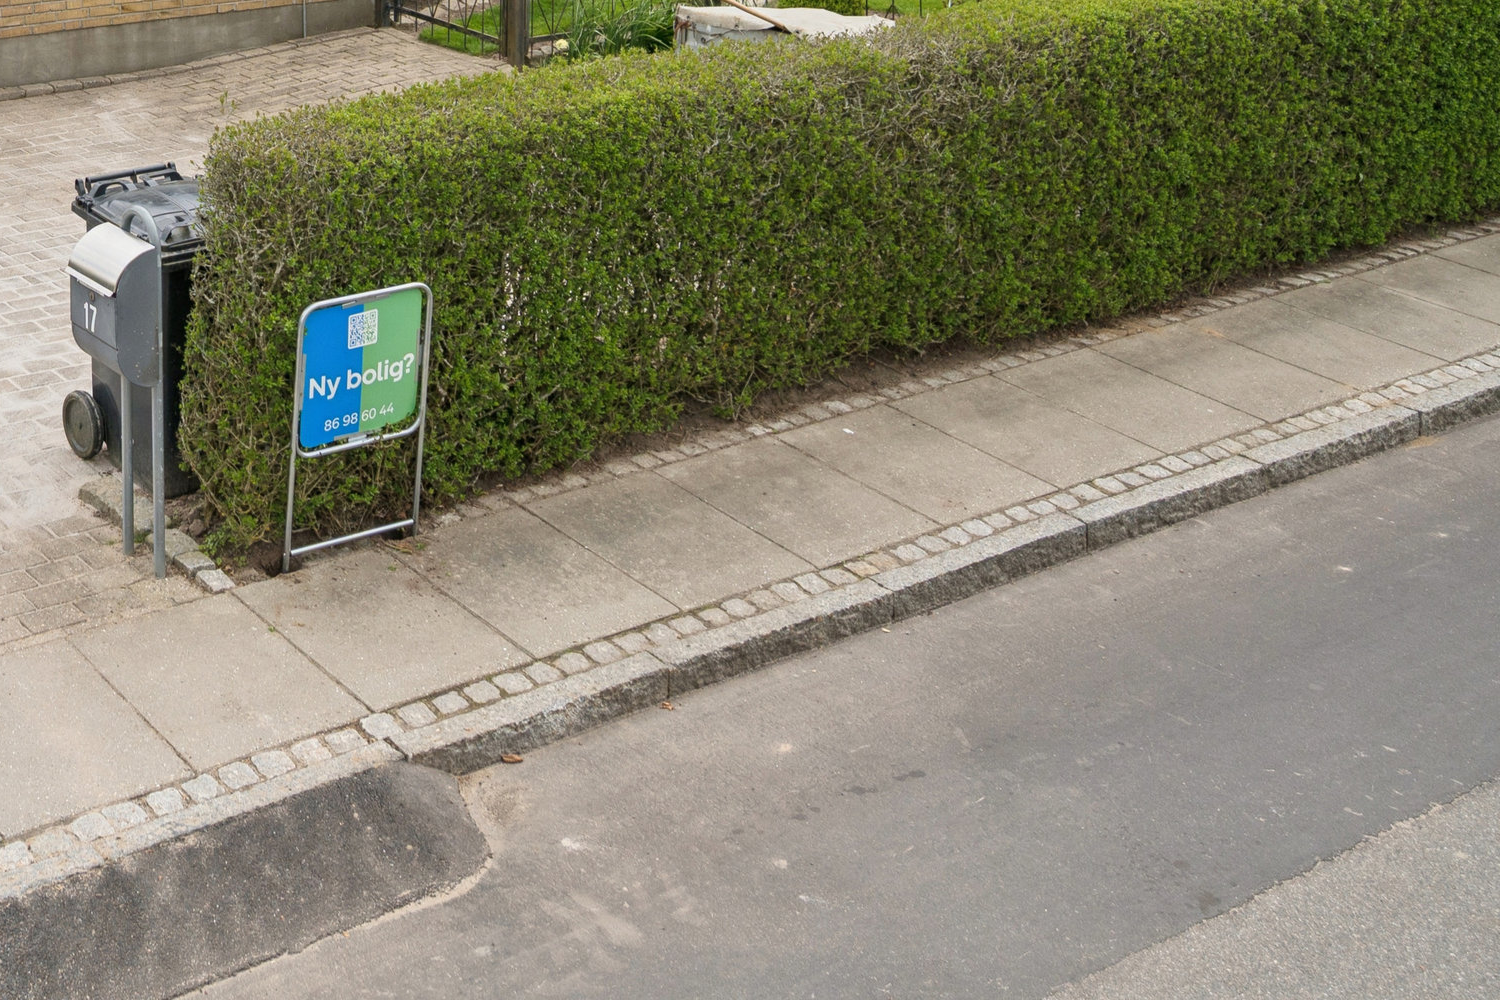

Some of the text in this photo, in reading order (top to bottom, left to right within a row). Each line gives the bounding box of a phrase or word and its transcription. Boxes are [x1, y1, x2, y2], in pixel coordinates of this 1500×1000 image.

[83, 301, 97, 333] 17
[309, 352, 415, 400] Ny bolig?
[324, 402, 394, 432] 86 98 60 44
